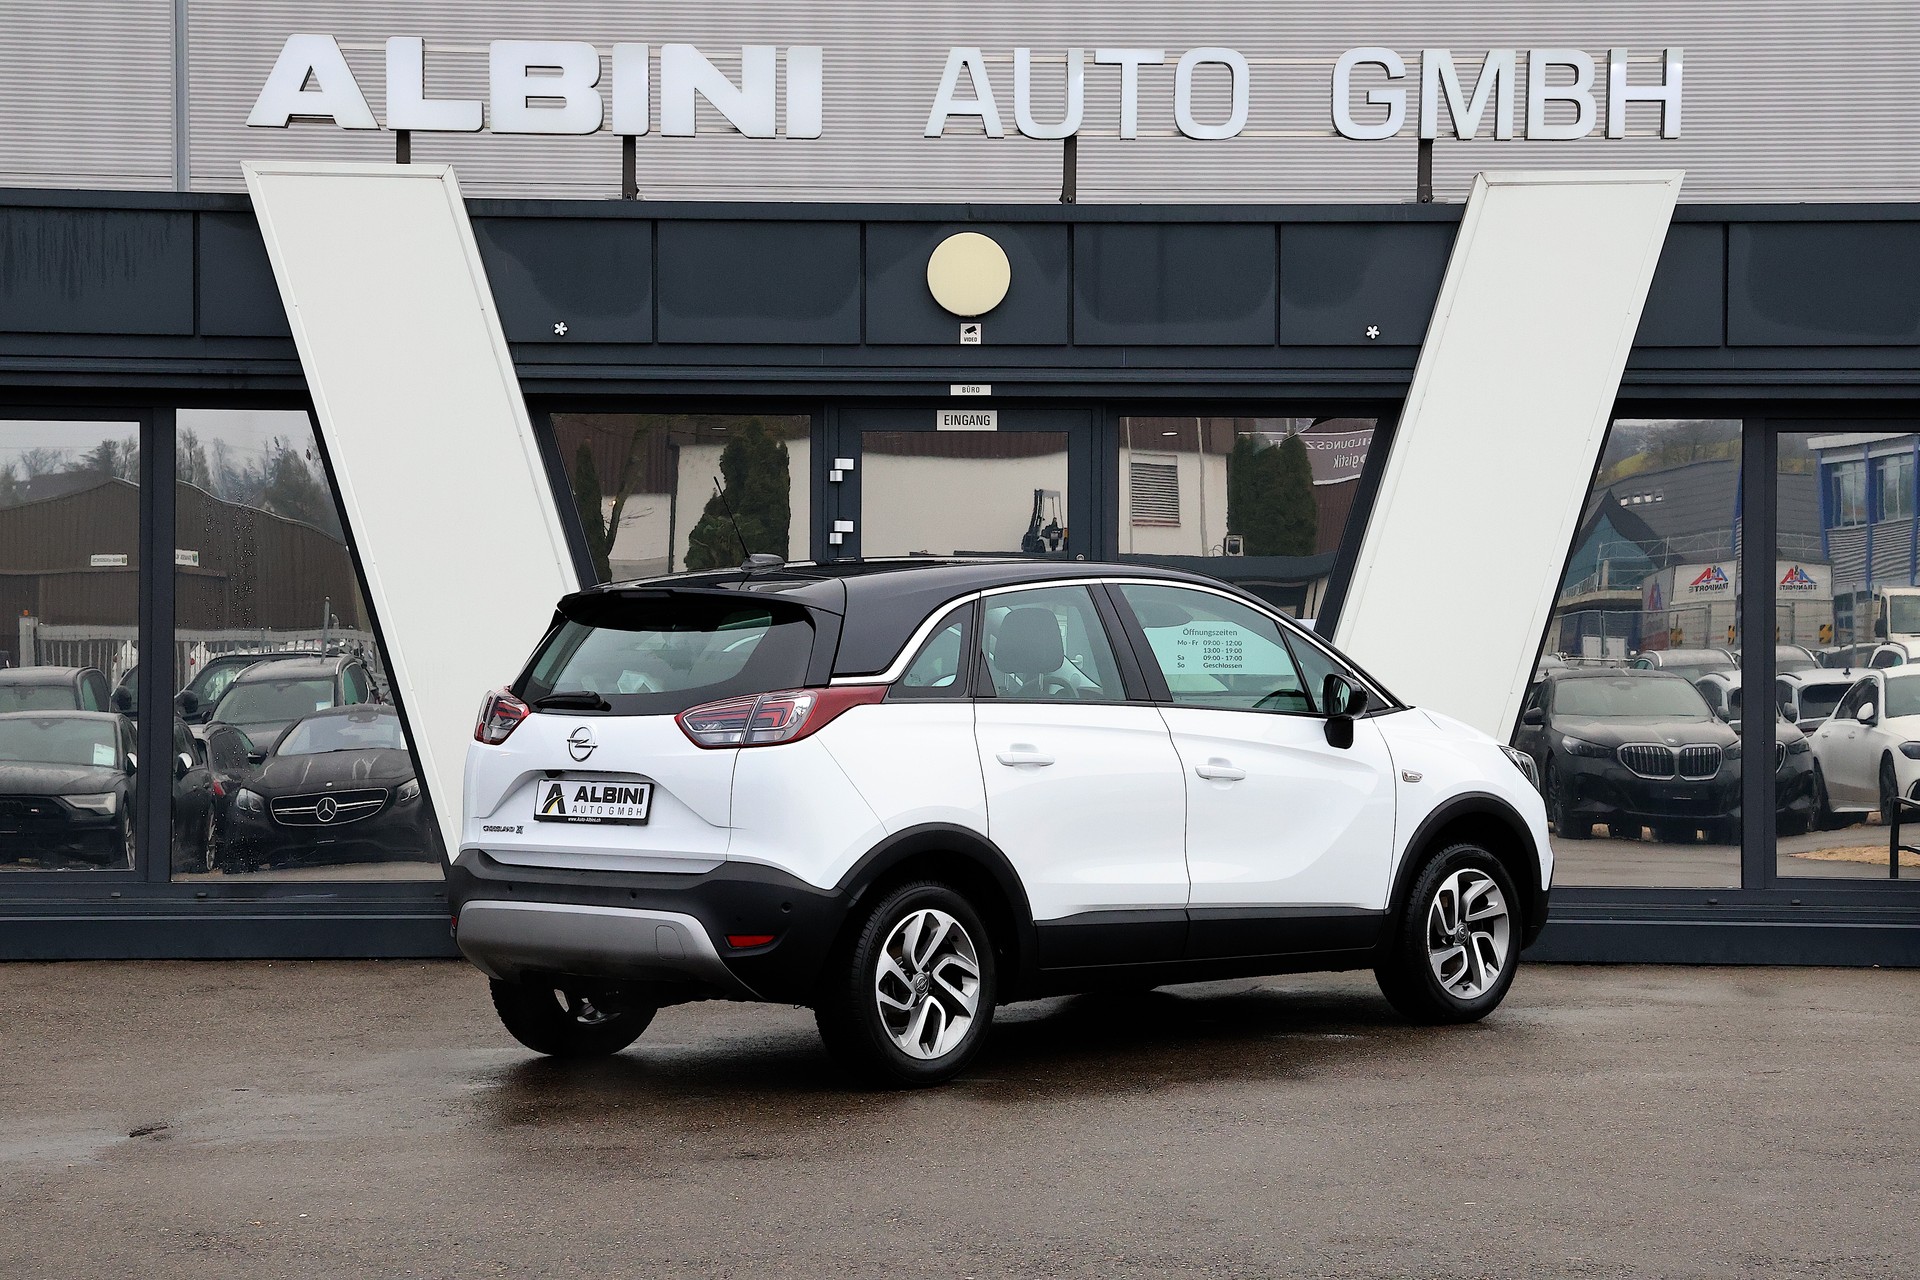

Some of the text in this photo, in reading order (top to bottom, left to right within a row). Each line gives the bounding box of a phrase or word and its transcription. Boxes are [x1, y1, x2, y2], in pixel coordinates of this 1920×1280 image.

[246, 34, 1685, 141] ALBINI AUTO GMBH
[961, 385, 980, 394] BÜRO
[944, 414, 991, 426] EINGANG
[1182, 628, 1238, 637] Öffnungszeiten
[573, 785, 645, 805] ALBINI
[571, 805, 643, 817] AUTO GMBH
